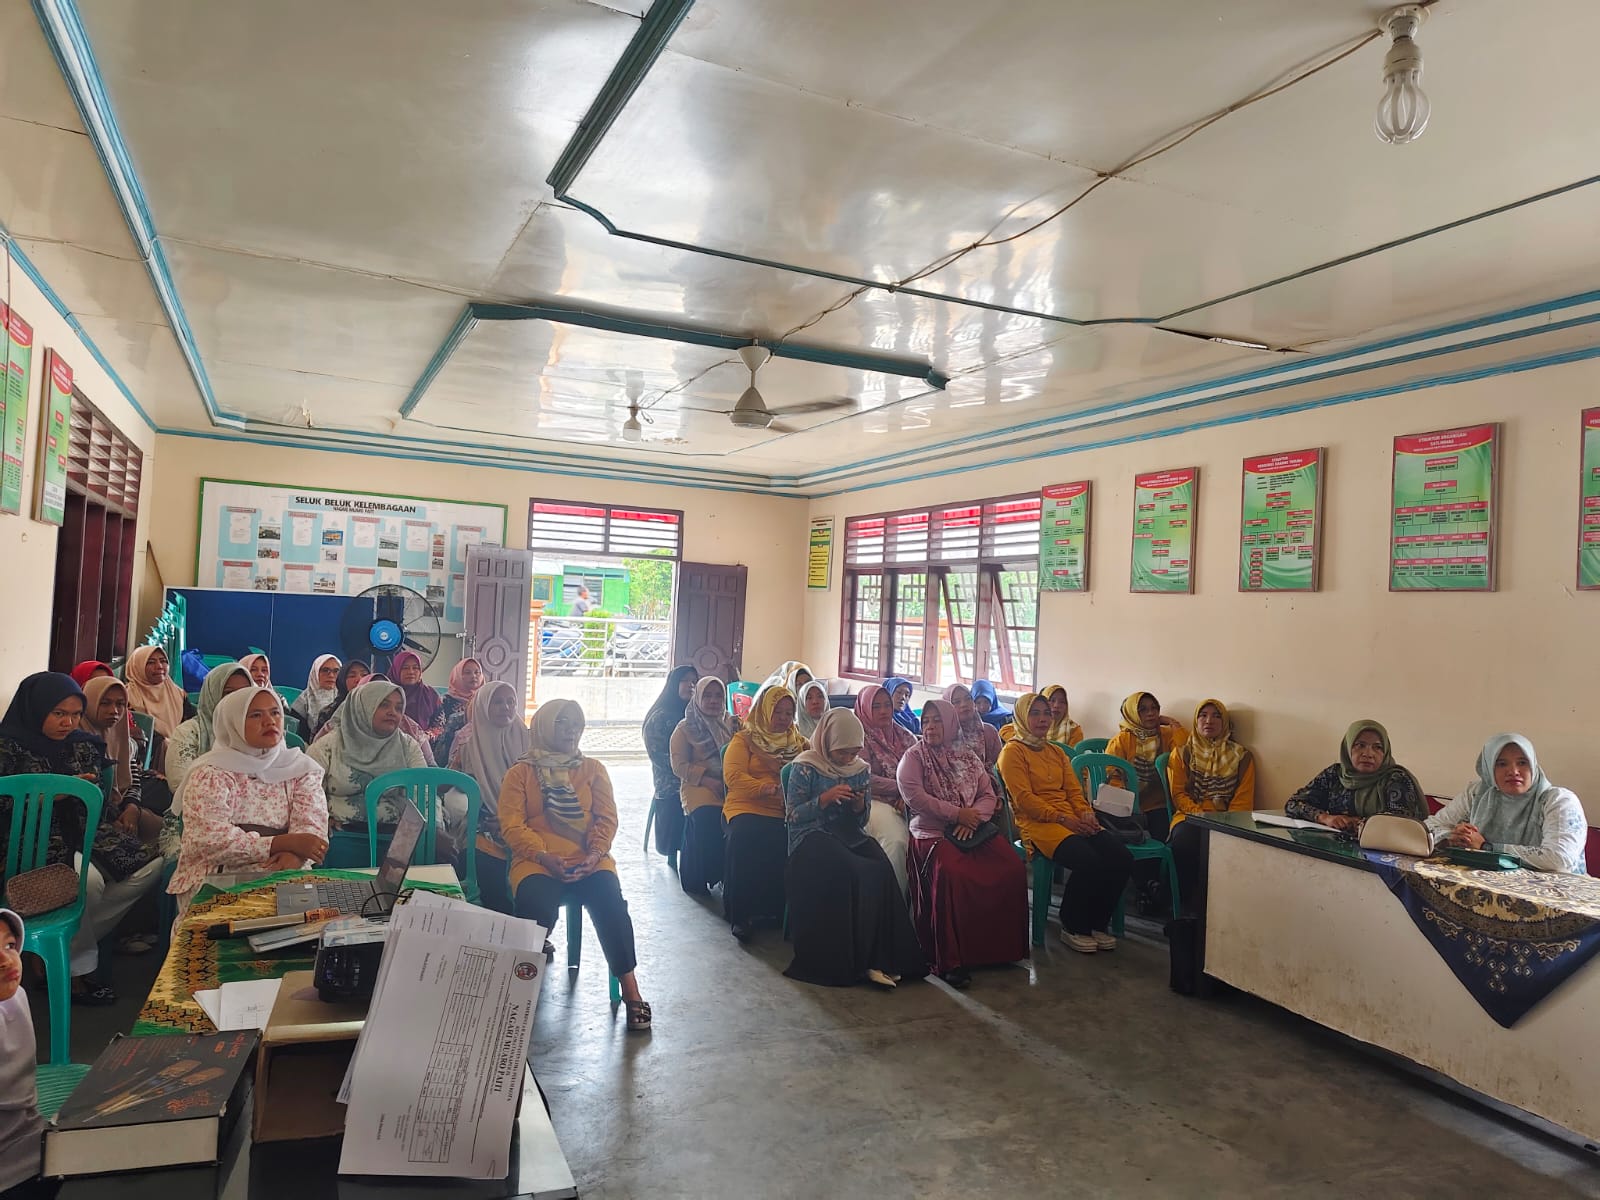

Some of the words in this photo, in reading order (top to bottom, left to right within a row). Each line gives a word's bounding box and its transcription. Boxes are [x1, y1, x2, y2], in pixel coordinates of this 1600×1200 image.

[295, 496, 322, 505] SELUK
[324, 498, 351, 507] BELUK
[353, 500, 416, 513] KELEMBAGAAN
[506, 1005, 519, 1038] NAGARI
[499, 1040, 511, 1069] MUARO
[494, 1070, 505, 1092] PAITI
